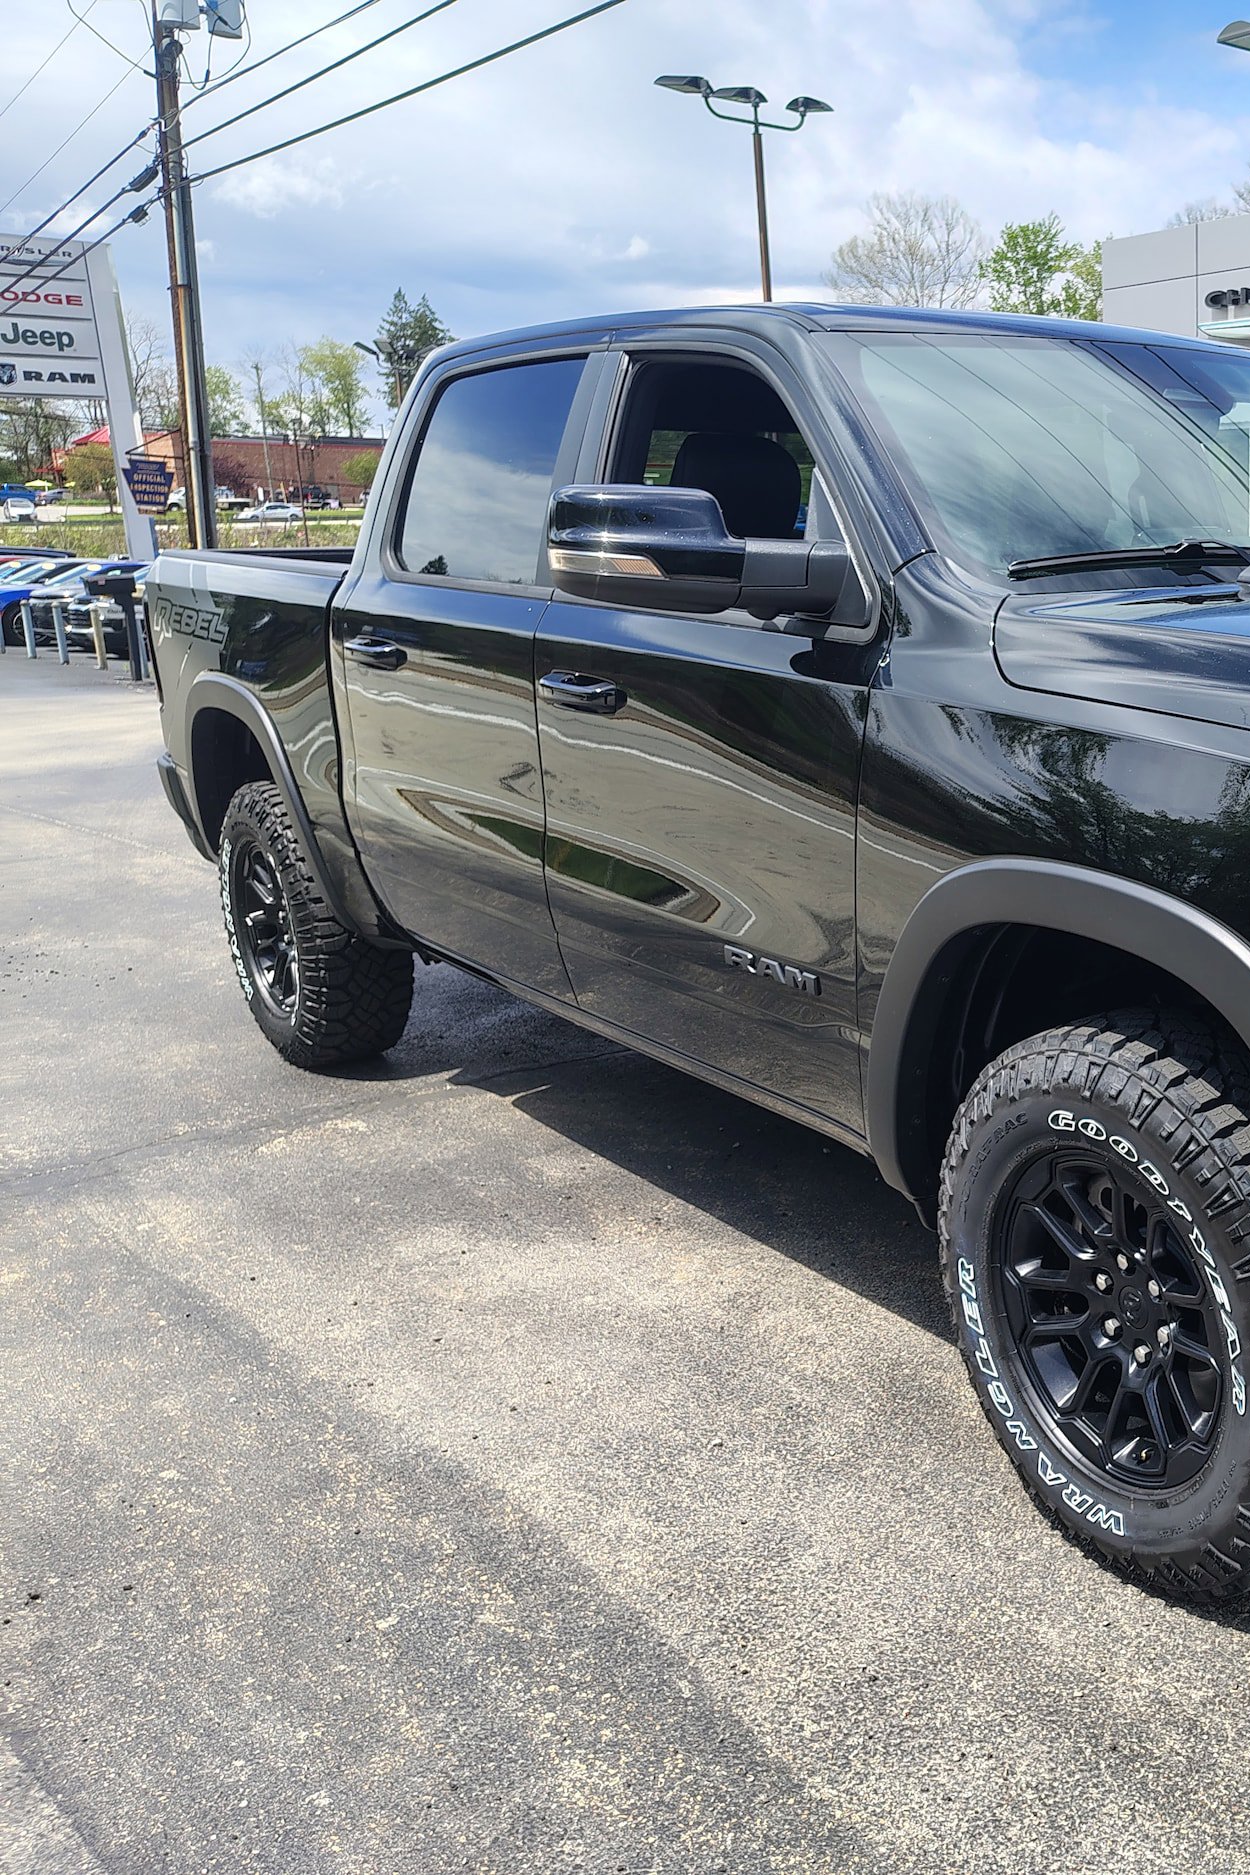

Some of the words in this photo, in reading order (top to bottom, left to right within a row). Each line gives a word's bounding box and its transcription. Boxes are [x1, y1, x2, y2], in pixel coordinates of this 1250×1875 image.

[0, 322, 75, 352] Jeep
[23, 370, 96, 384] RAM
[133, 473, 166, 483] OFFICIAL
[135, 493, 165, 503] STATION
[154, 597, 228, 646] REBEL
[724, 944, 822, 996] RAM
[1048, 1109, 1247, 1416] GOODYEAR
[957, 1257, 1126, 1538] WRANGLER
